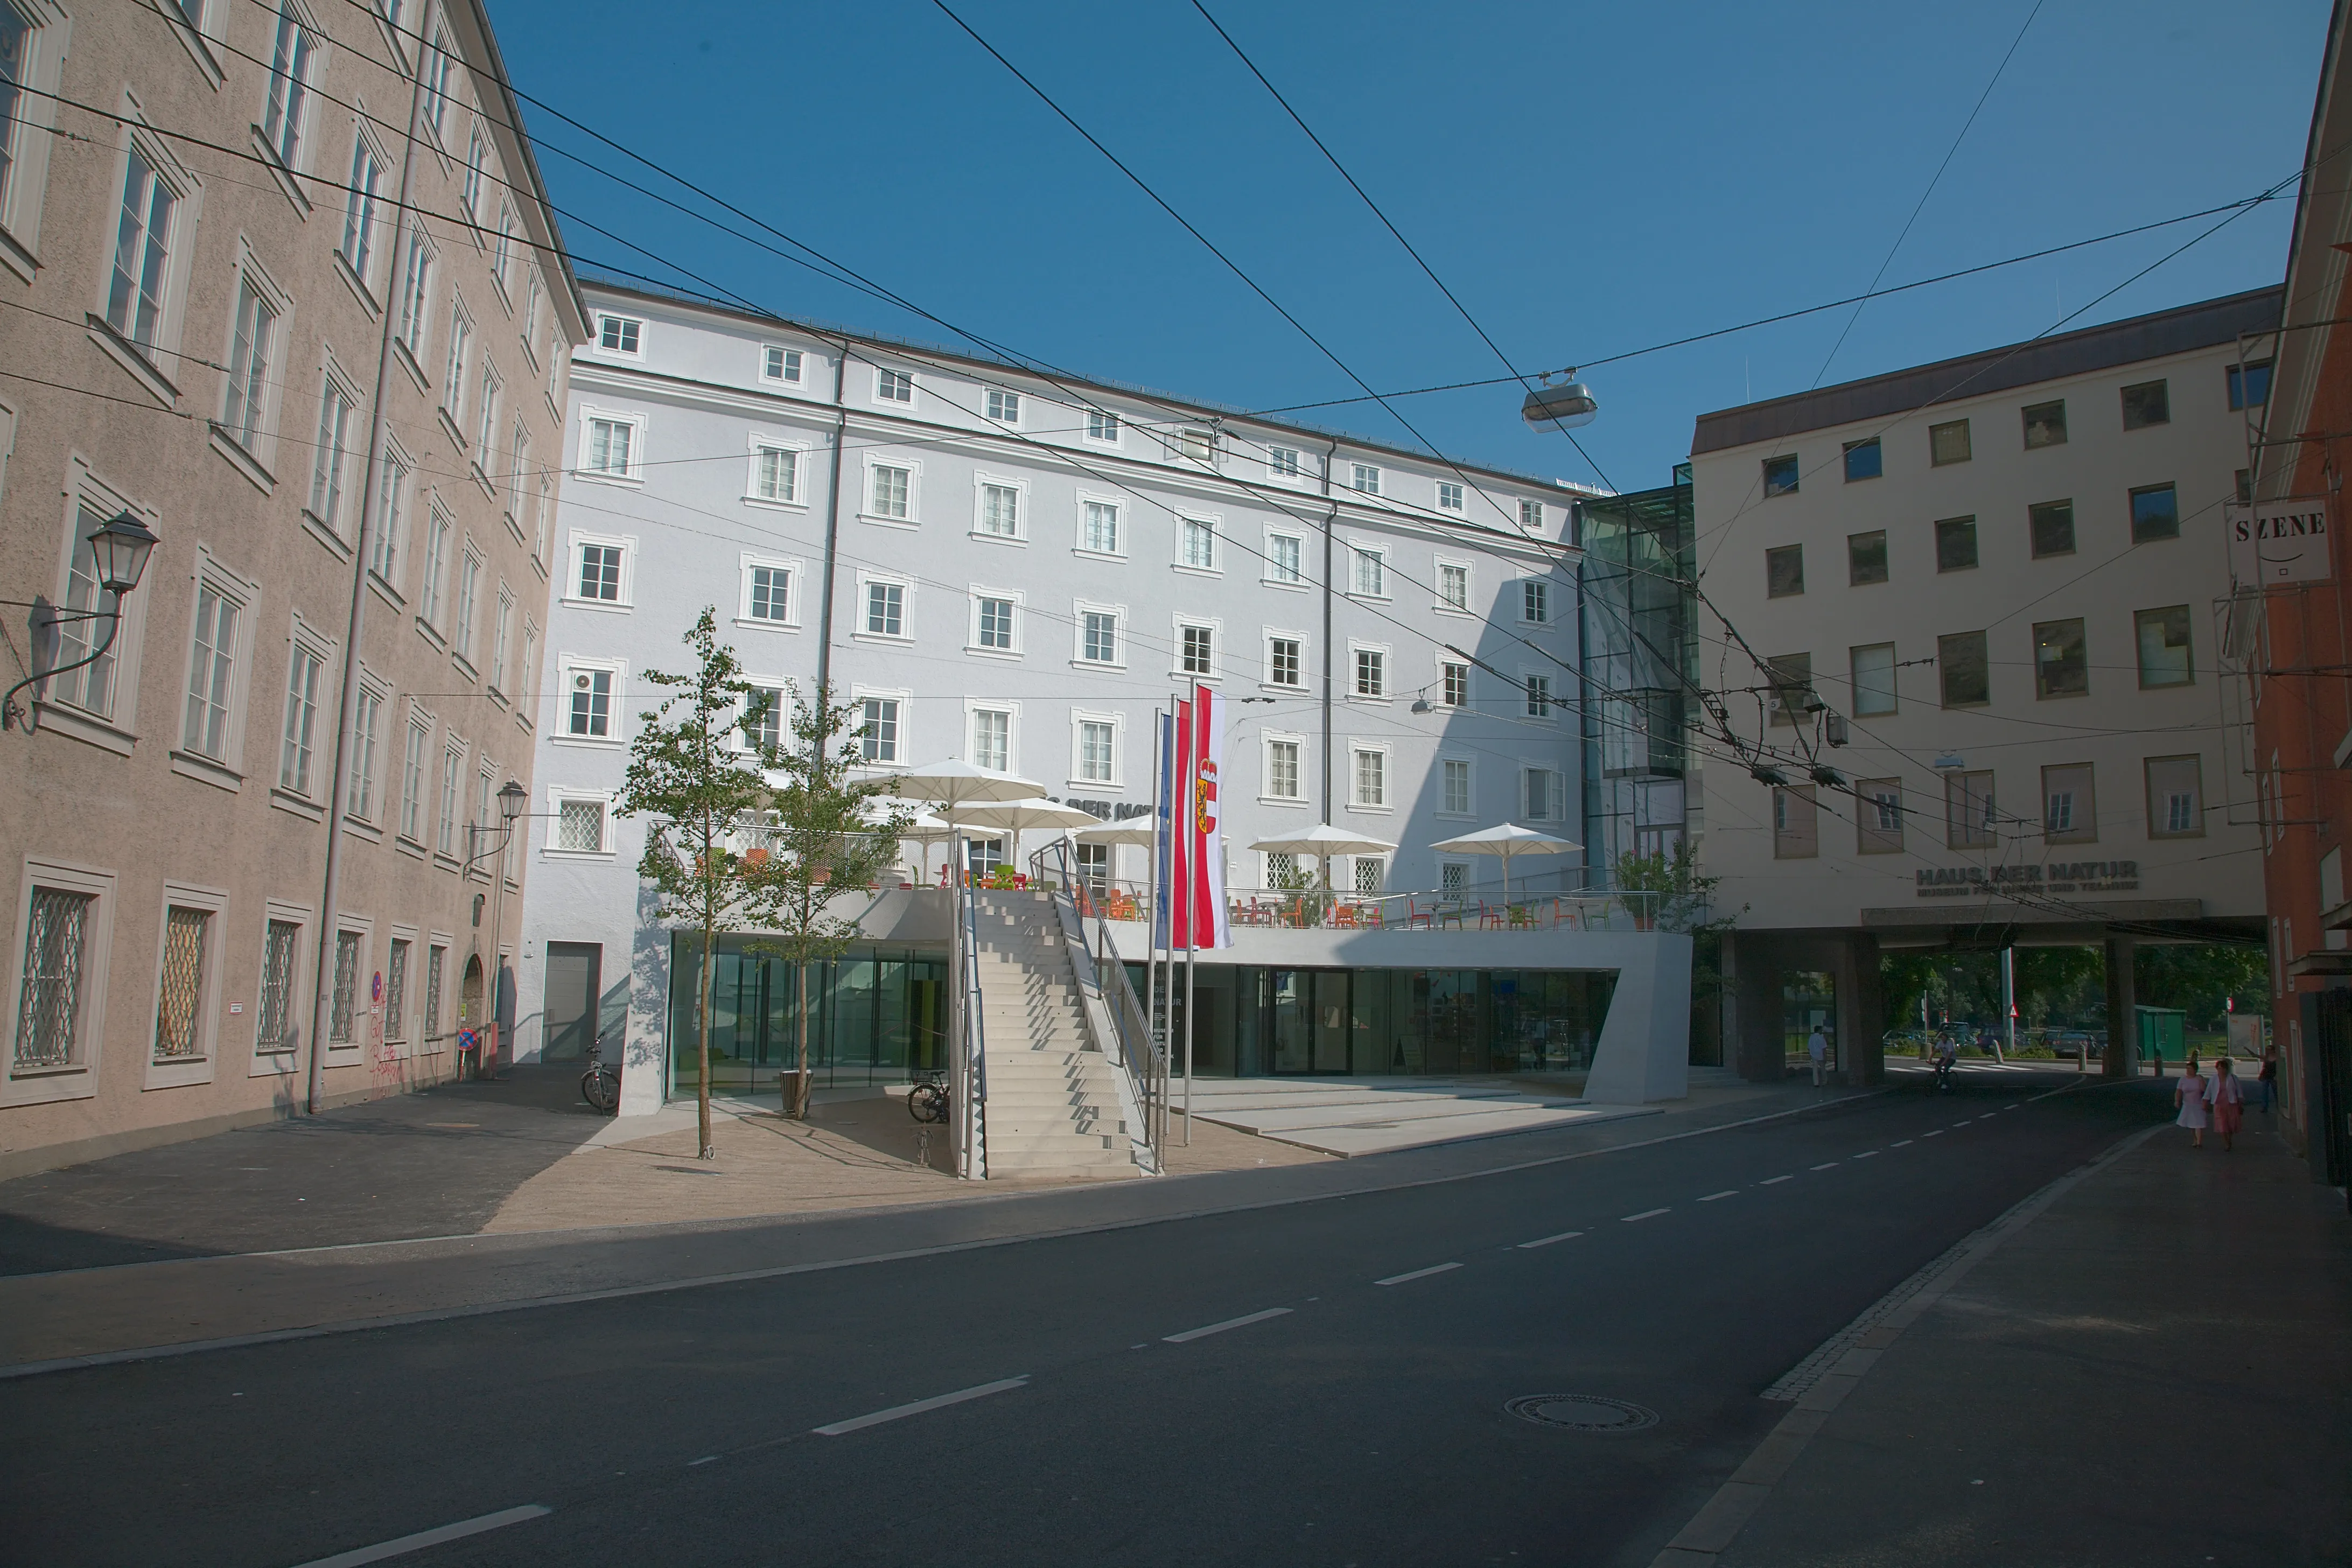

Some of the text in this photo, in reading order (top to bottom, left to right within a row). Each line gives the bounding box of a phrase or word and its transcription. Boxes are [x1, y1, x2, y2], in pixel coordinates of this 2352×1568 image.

[2236, 513, 2325, 542] SZENE
[1066, 799, 1112, 818] DER
[1916, 860, 2138, 885] HAUS DER NATUR
[1917, 887, 1969, 897] MUSEUM
[2048, 883, 2075, 892] UND
[1154, 974, 1177, 982] HAS
[1153, 998, 1182, 1006] NAUR
